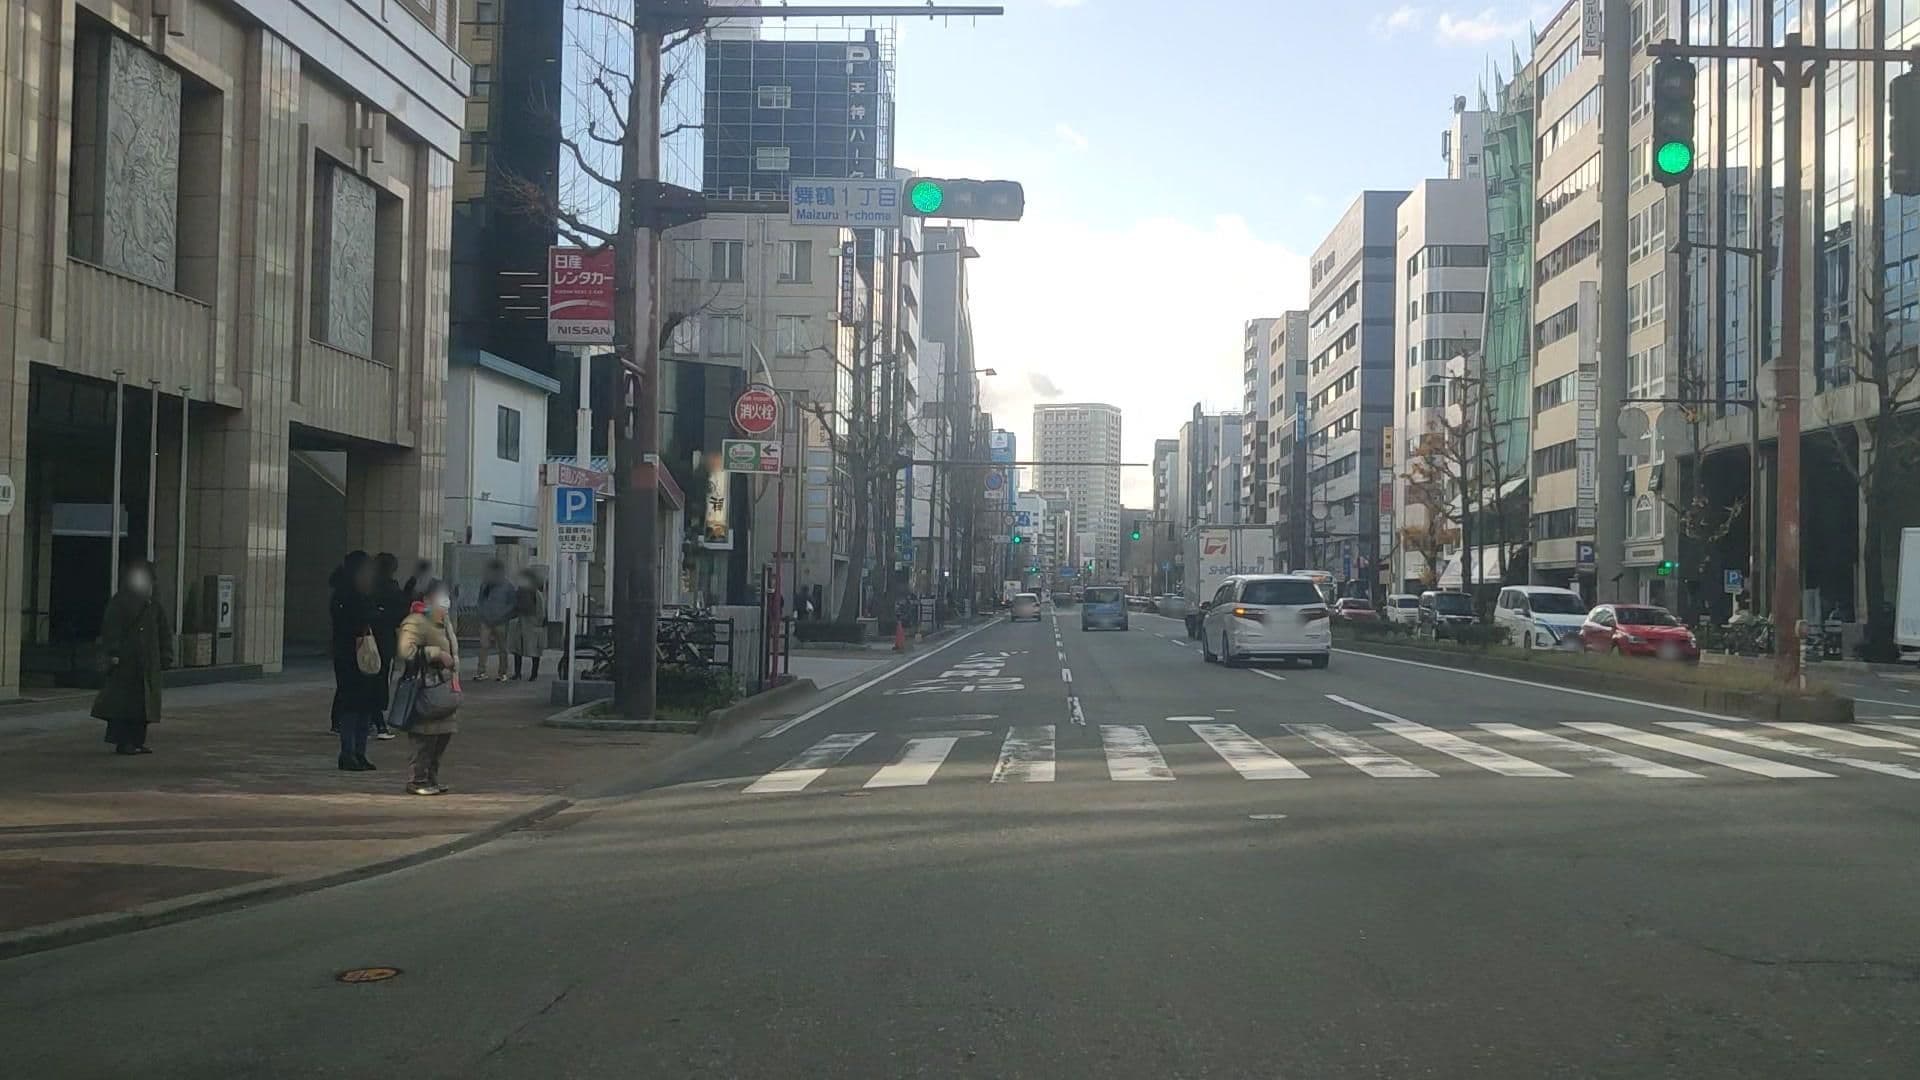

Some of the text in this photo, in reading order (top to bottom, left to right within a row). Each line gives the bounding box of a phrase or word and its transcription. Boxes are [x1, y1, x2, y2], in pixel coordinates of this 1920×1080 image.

[796, 209, 839, 220] Maizuru
[555, 254, 583, 269] 日産
[554, 271, 614, 285] レンタカー
[557, 326, 610, 335] NISSAN
[740, 403, 774, 421] 消火栓
[566, 490, 587, 521] P
[1580, 545, 1593, 561] P
